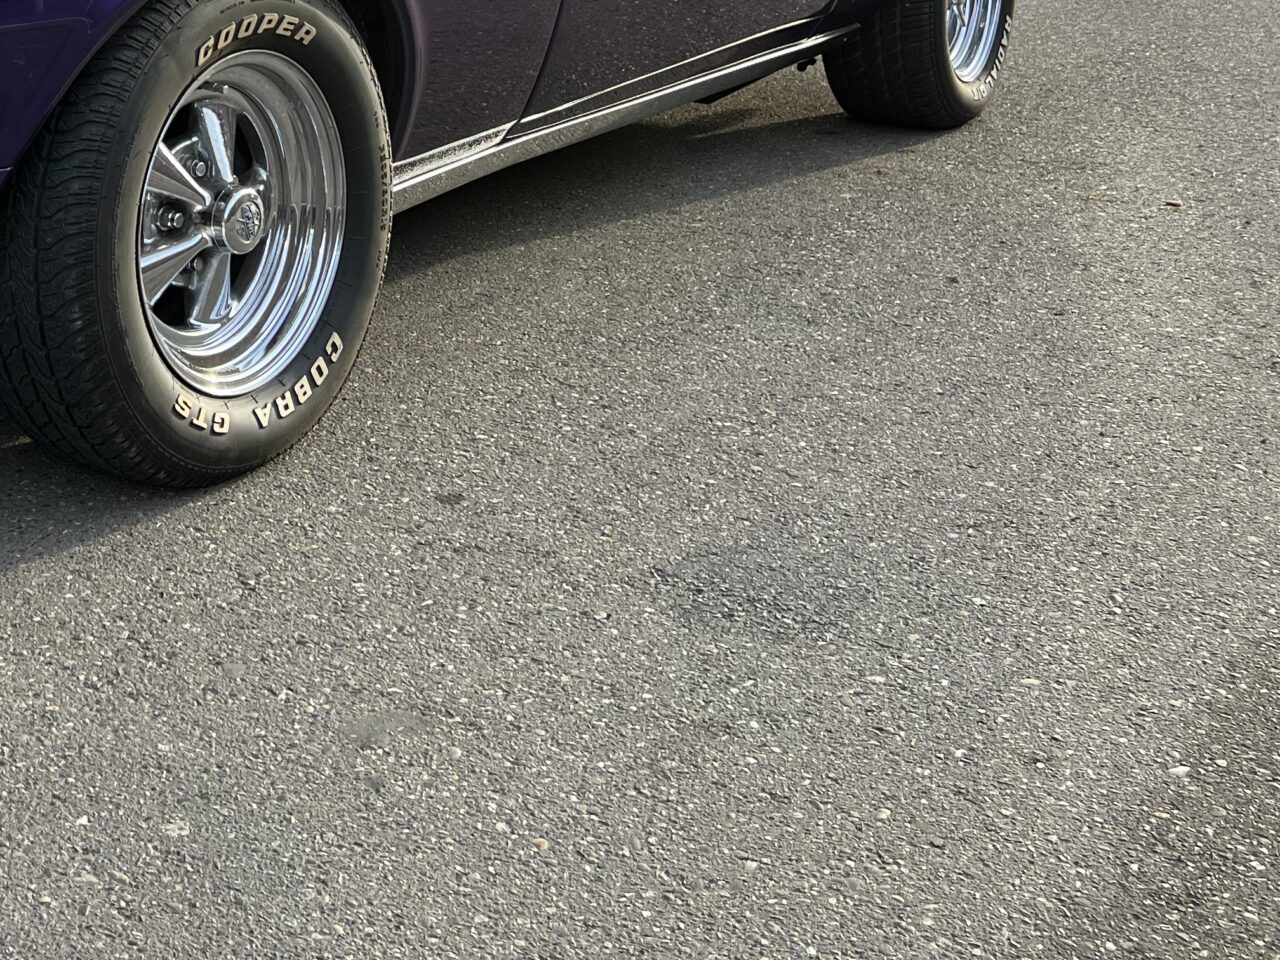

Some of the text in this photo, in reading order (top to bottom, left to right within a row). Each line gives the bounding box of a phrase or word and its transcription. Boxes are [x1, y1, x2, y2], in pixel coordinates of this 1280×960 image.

[197, 12, 317, 66] COOPER
[985, 14, 1012, 88] RADIAL
[173, 331, 344, 434] COBRA GTS
